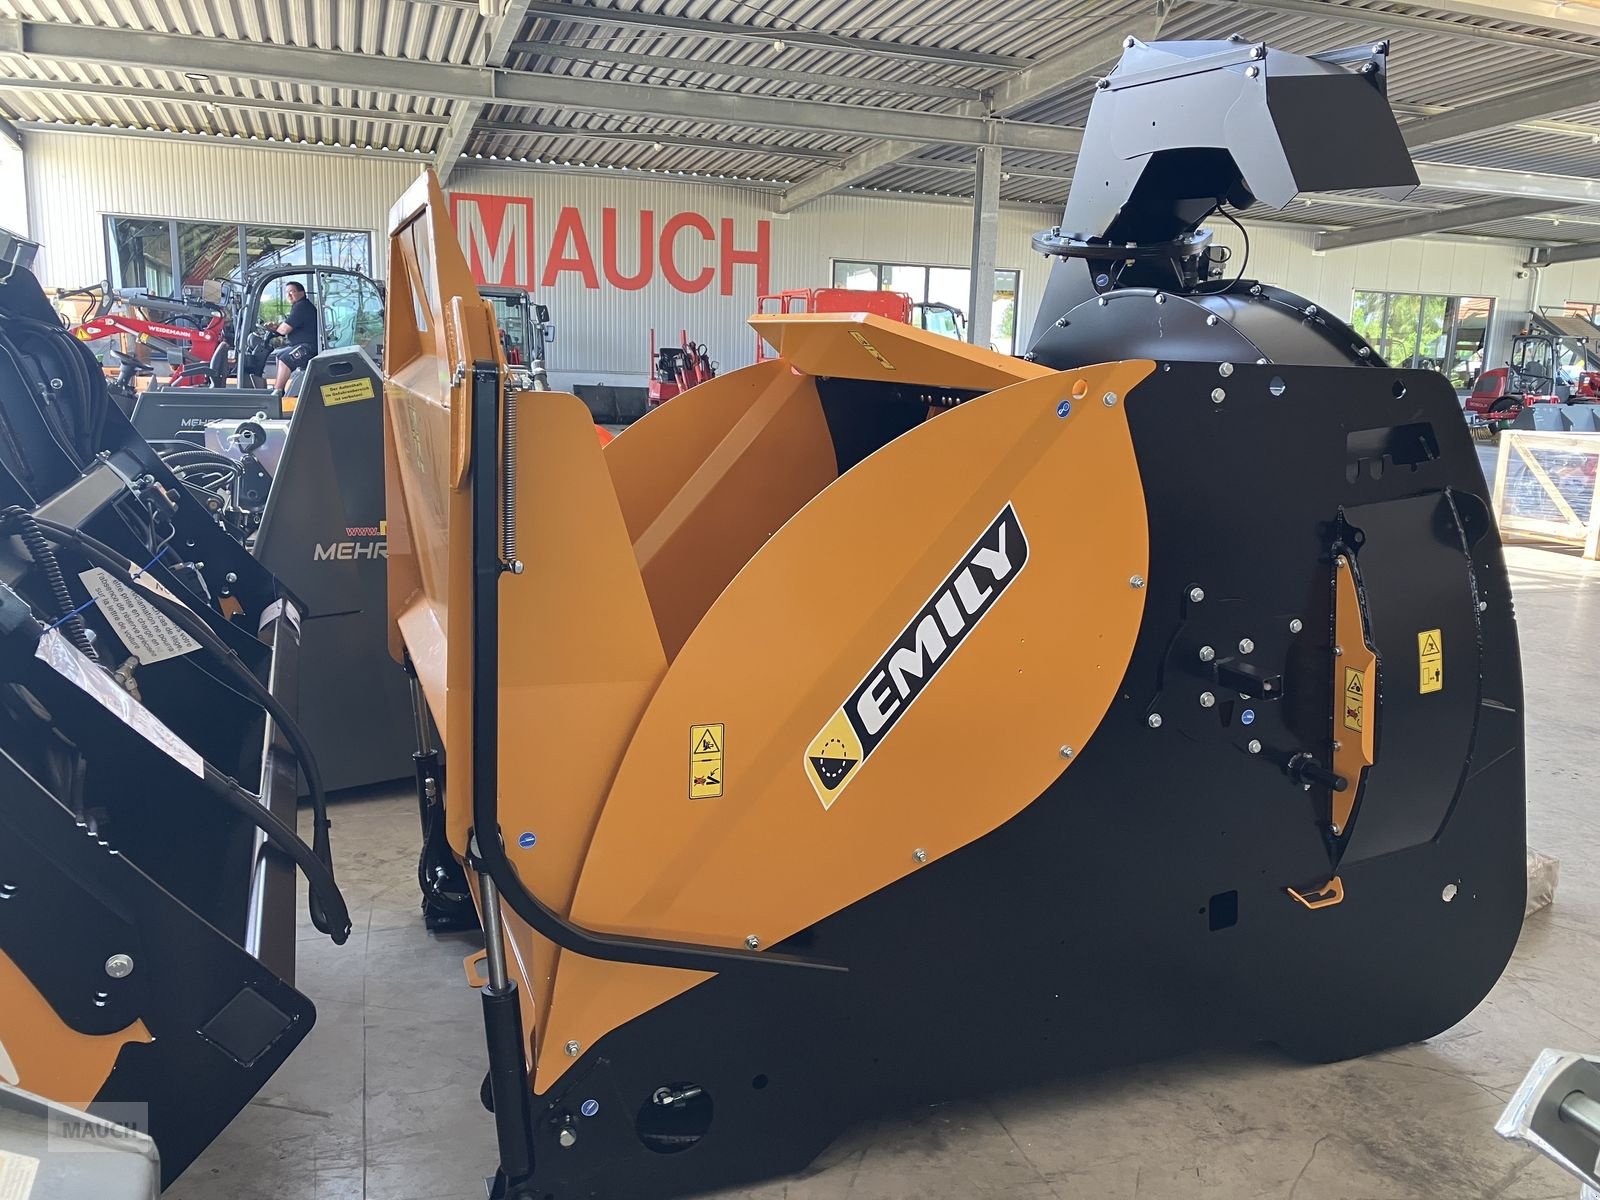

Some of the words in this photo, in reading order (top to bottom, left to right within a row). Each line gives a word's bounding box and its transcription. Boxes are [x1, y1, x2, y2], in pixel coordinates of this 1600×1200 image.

[450, 193, 770, 296] MAUCH
[148, 325, 191, 338] WEIDEMANN
[96, 588, 105, 597] sur
[107, 606, 120, 620] lettre
[117, 603, 124, 611] de
[121, 593, 134, 608] prise
[137, 618, 153, 638] charge
[151, 638, 159, 646] en
[158, 615, 168, 626] cas
[166, 627, 173, 635] de
[857, 521, 1012, 735] EMILY
[159, 634, 174, 652] pourra
